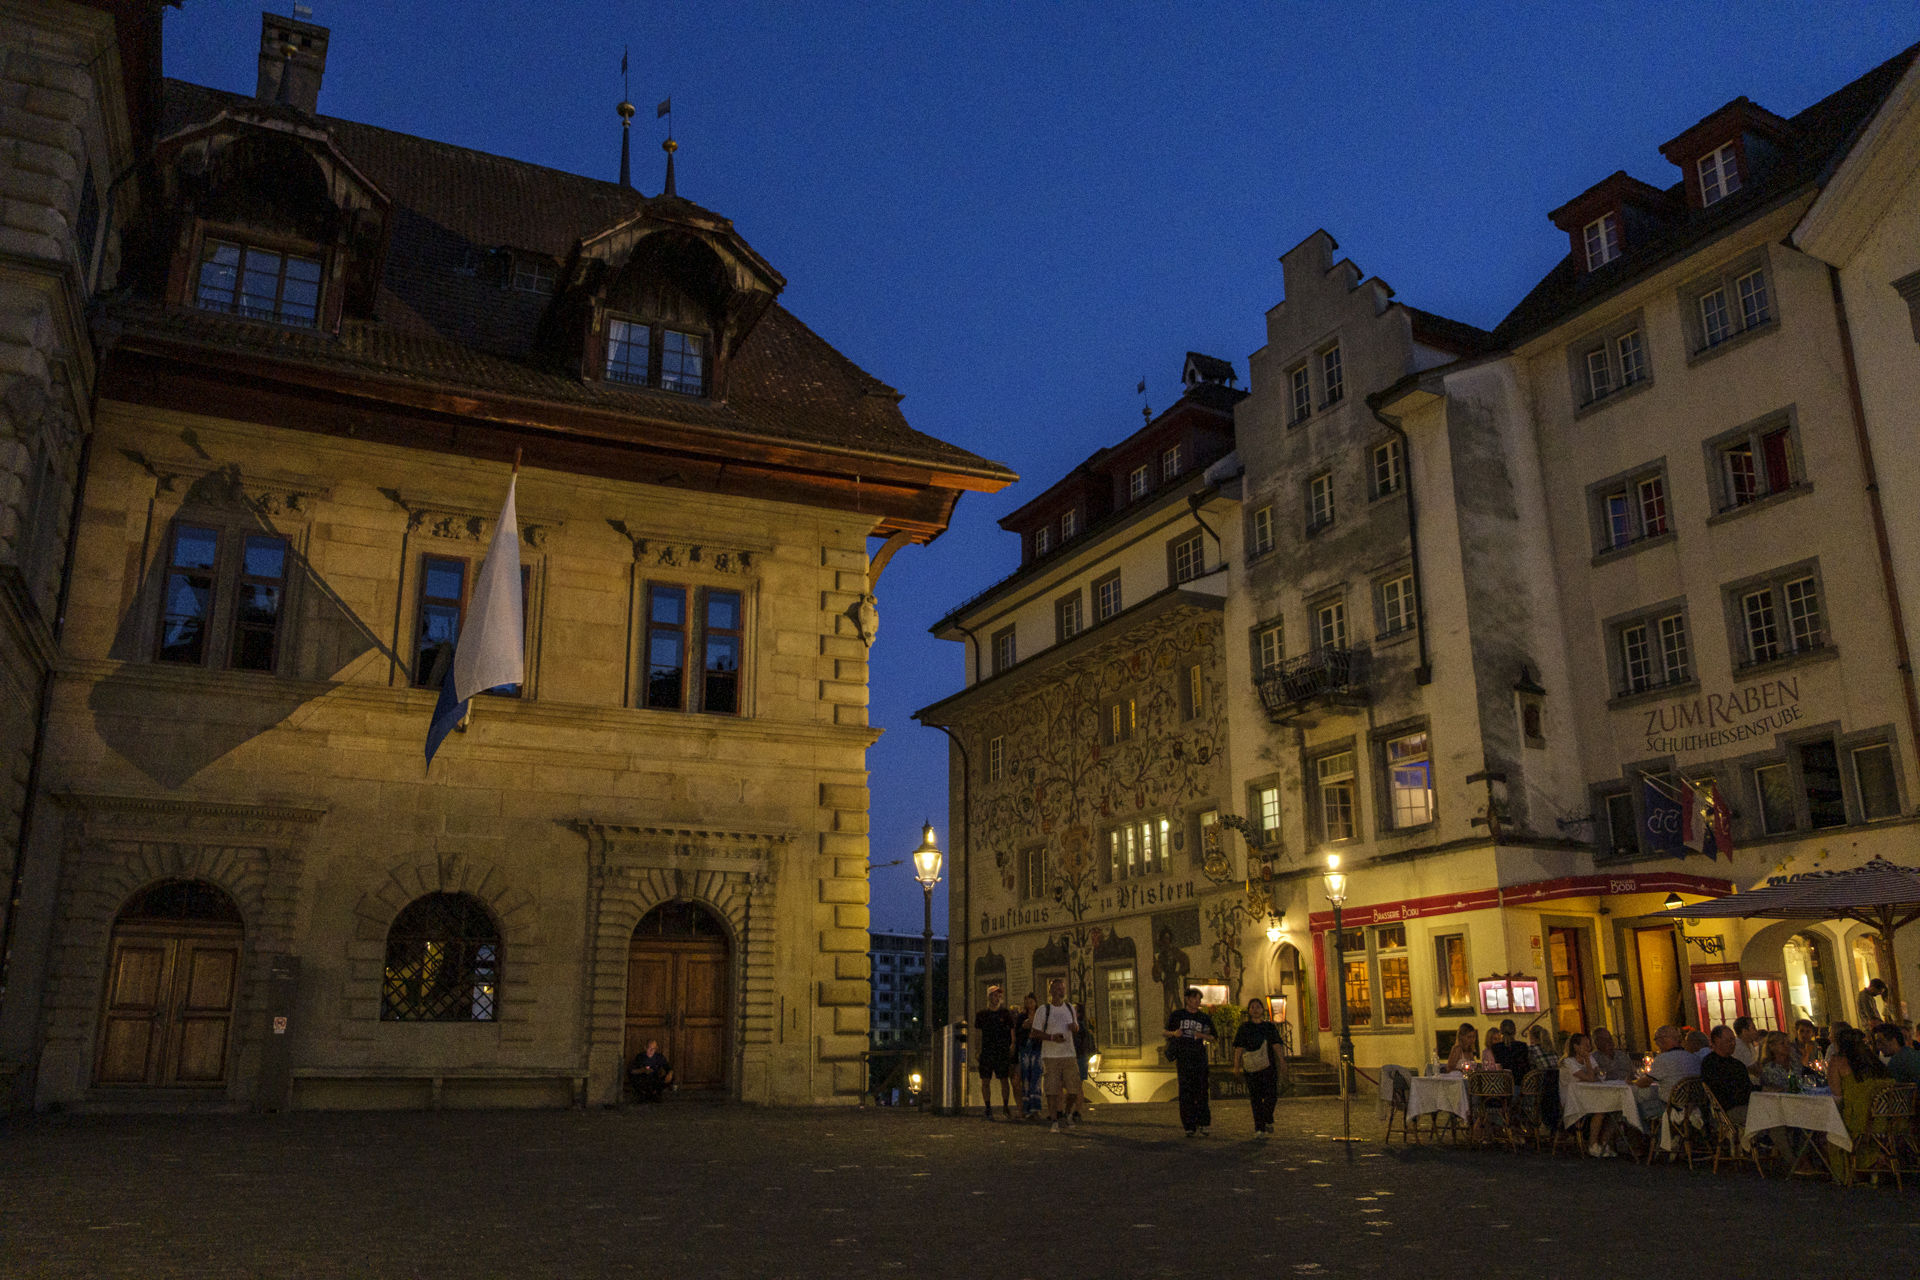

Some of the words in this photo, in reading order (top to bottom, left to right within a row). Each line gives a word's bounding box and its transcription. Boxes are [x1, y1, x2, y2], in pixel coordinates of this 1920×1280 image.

[1644, 701, 1704, 736] ZUM
[1707, 677, 1799, 728] RABEN
[1646, 704, 1803, 751] SCHULTHEISSENSTUBE
